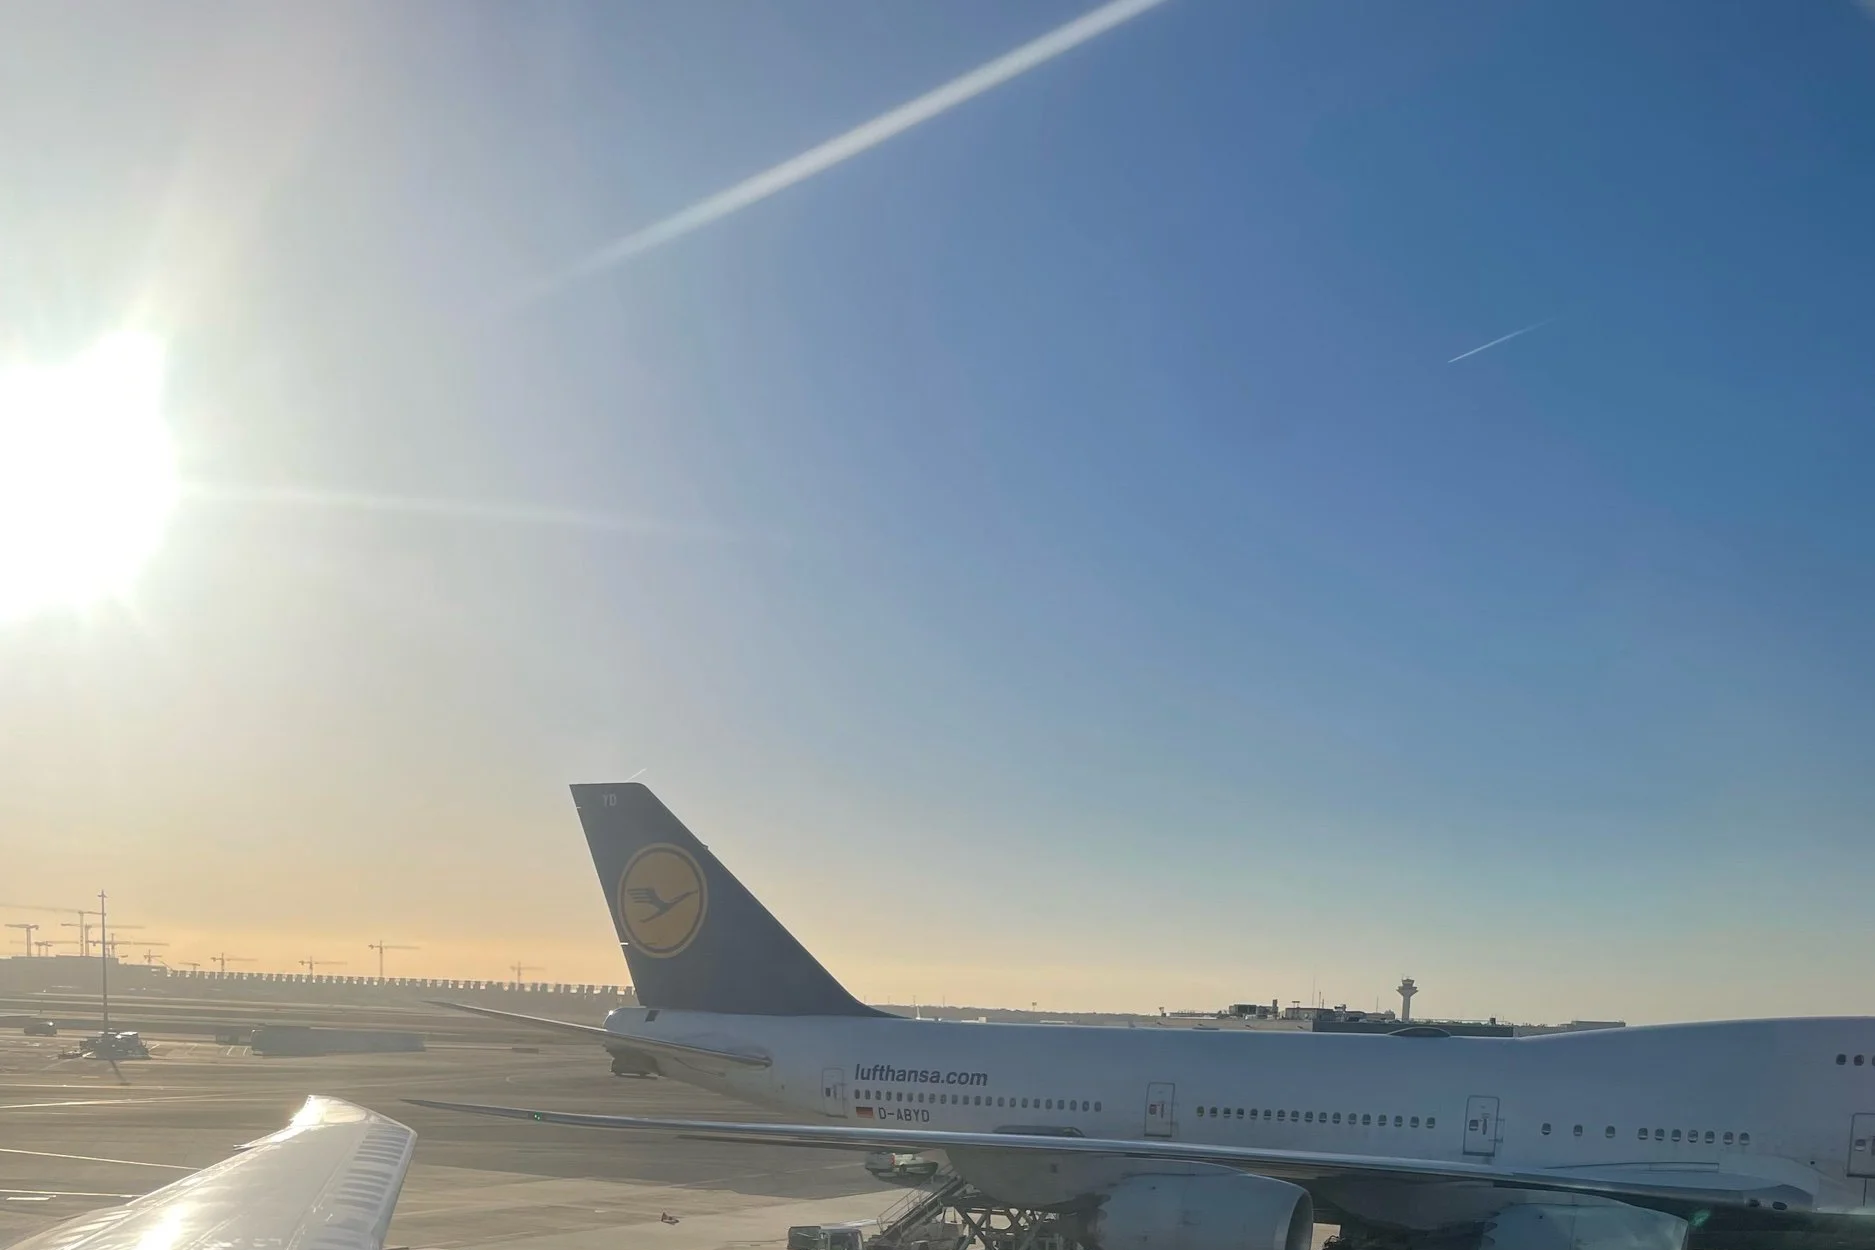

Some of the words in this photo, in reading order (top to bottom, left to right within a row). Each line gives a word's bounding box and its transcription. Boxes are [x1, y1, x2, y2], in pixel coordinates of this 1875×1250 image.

[602, 793, 617, 807] YD
[854, 1063, 988, 1086] lufthansa.com
[878, 1106, 930, 1122] D-ABYD
